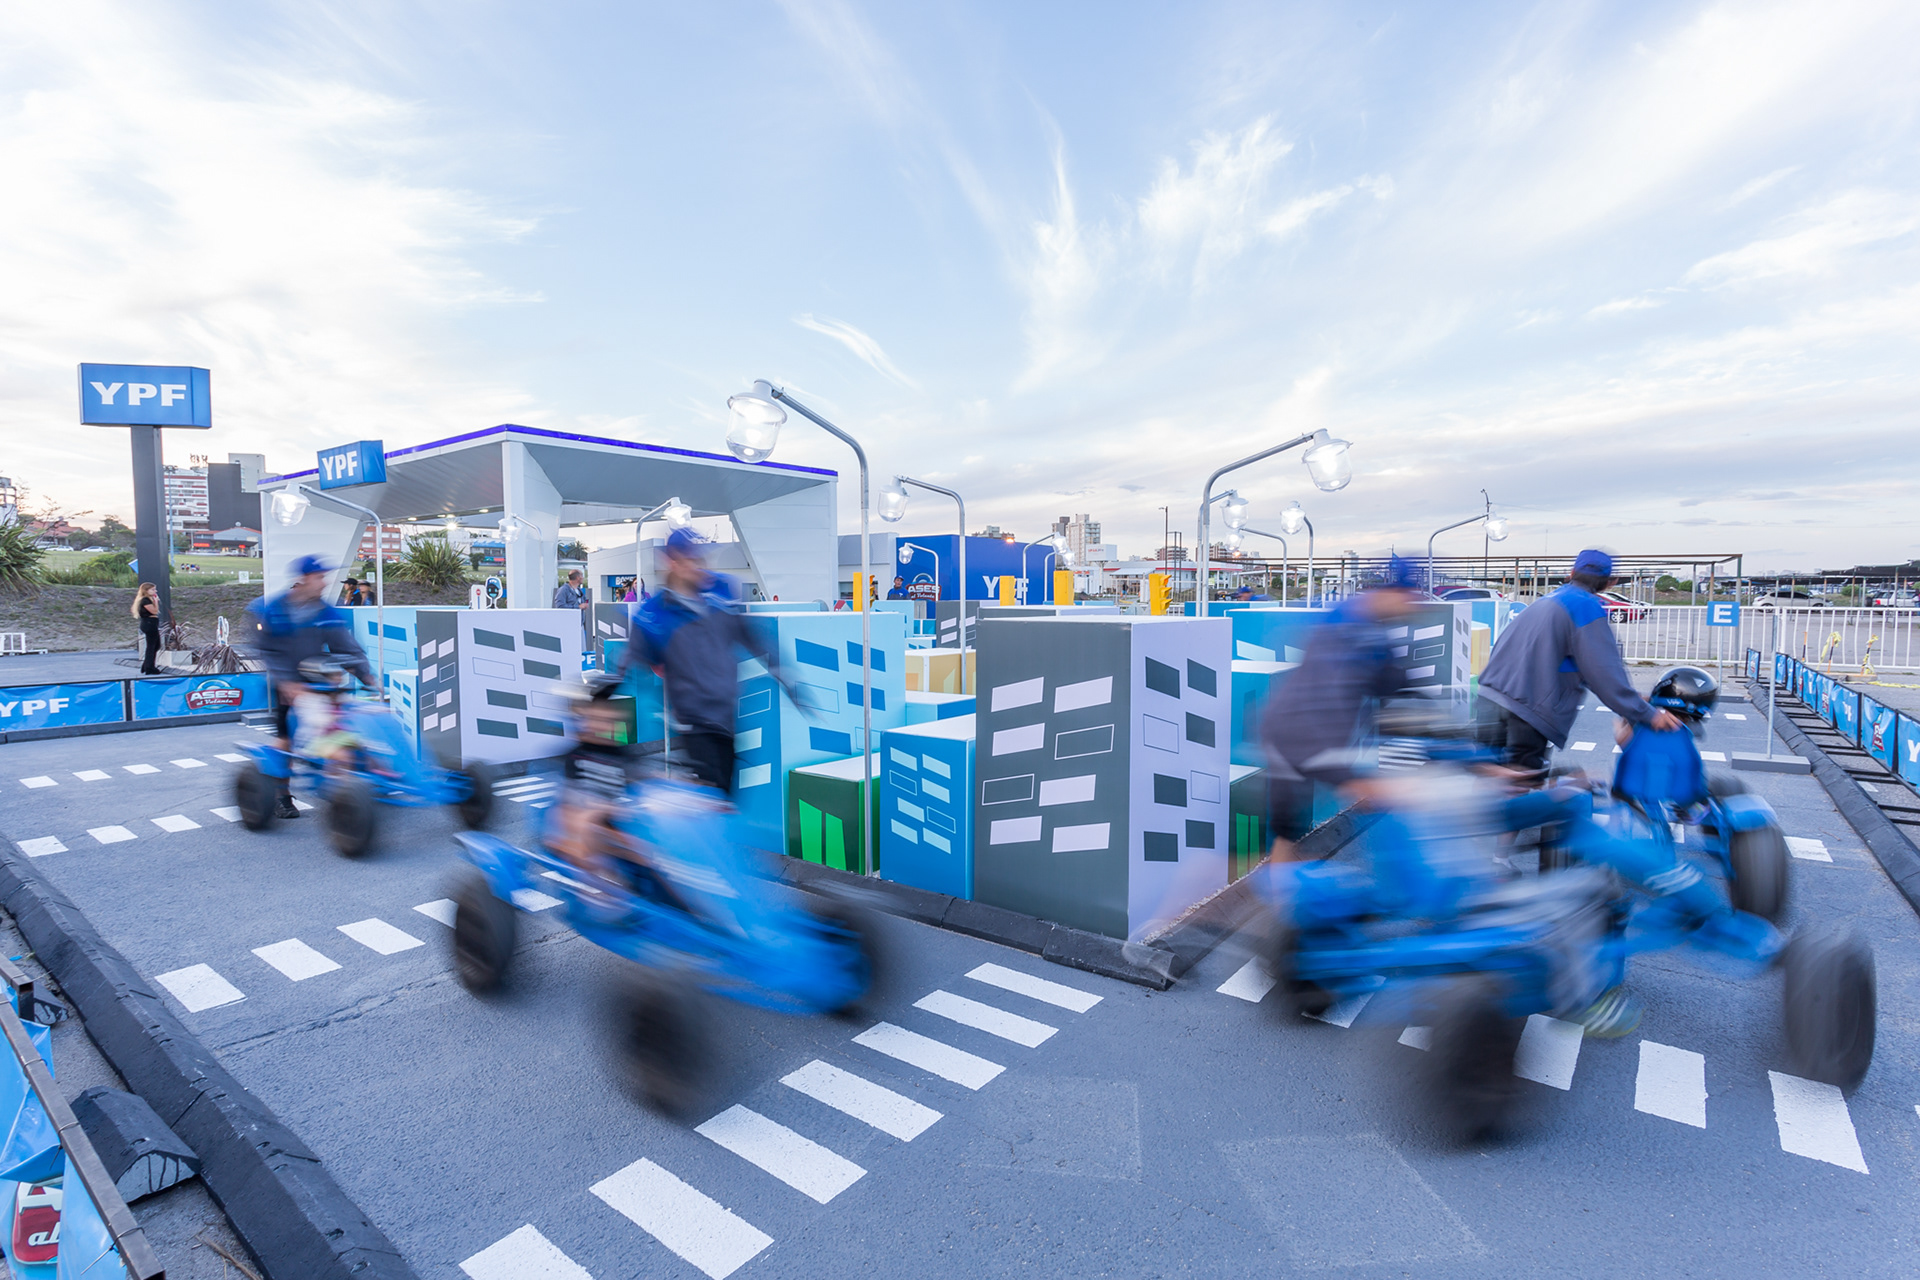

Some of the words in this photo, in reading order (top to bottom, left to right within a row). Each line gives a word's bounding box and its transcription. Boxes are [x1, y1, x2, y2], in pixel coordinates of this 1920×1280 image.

[89, 381, 187, 407] YPF
[321, 450, 358, 481] YPF
[982, 575, 1030, 599] YF
[1712, 604, 1733, 623] E
[190, 690, 241, 702] ASES
[0, 697, 70, 718] YPF
